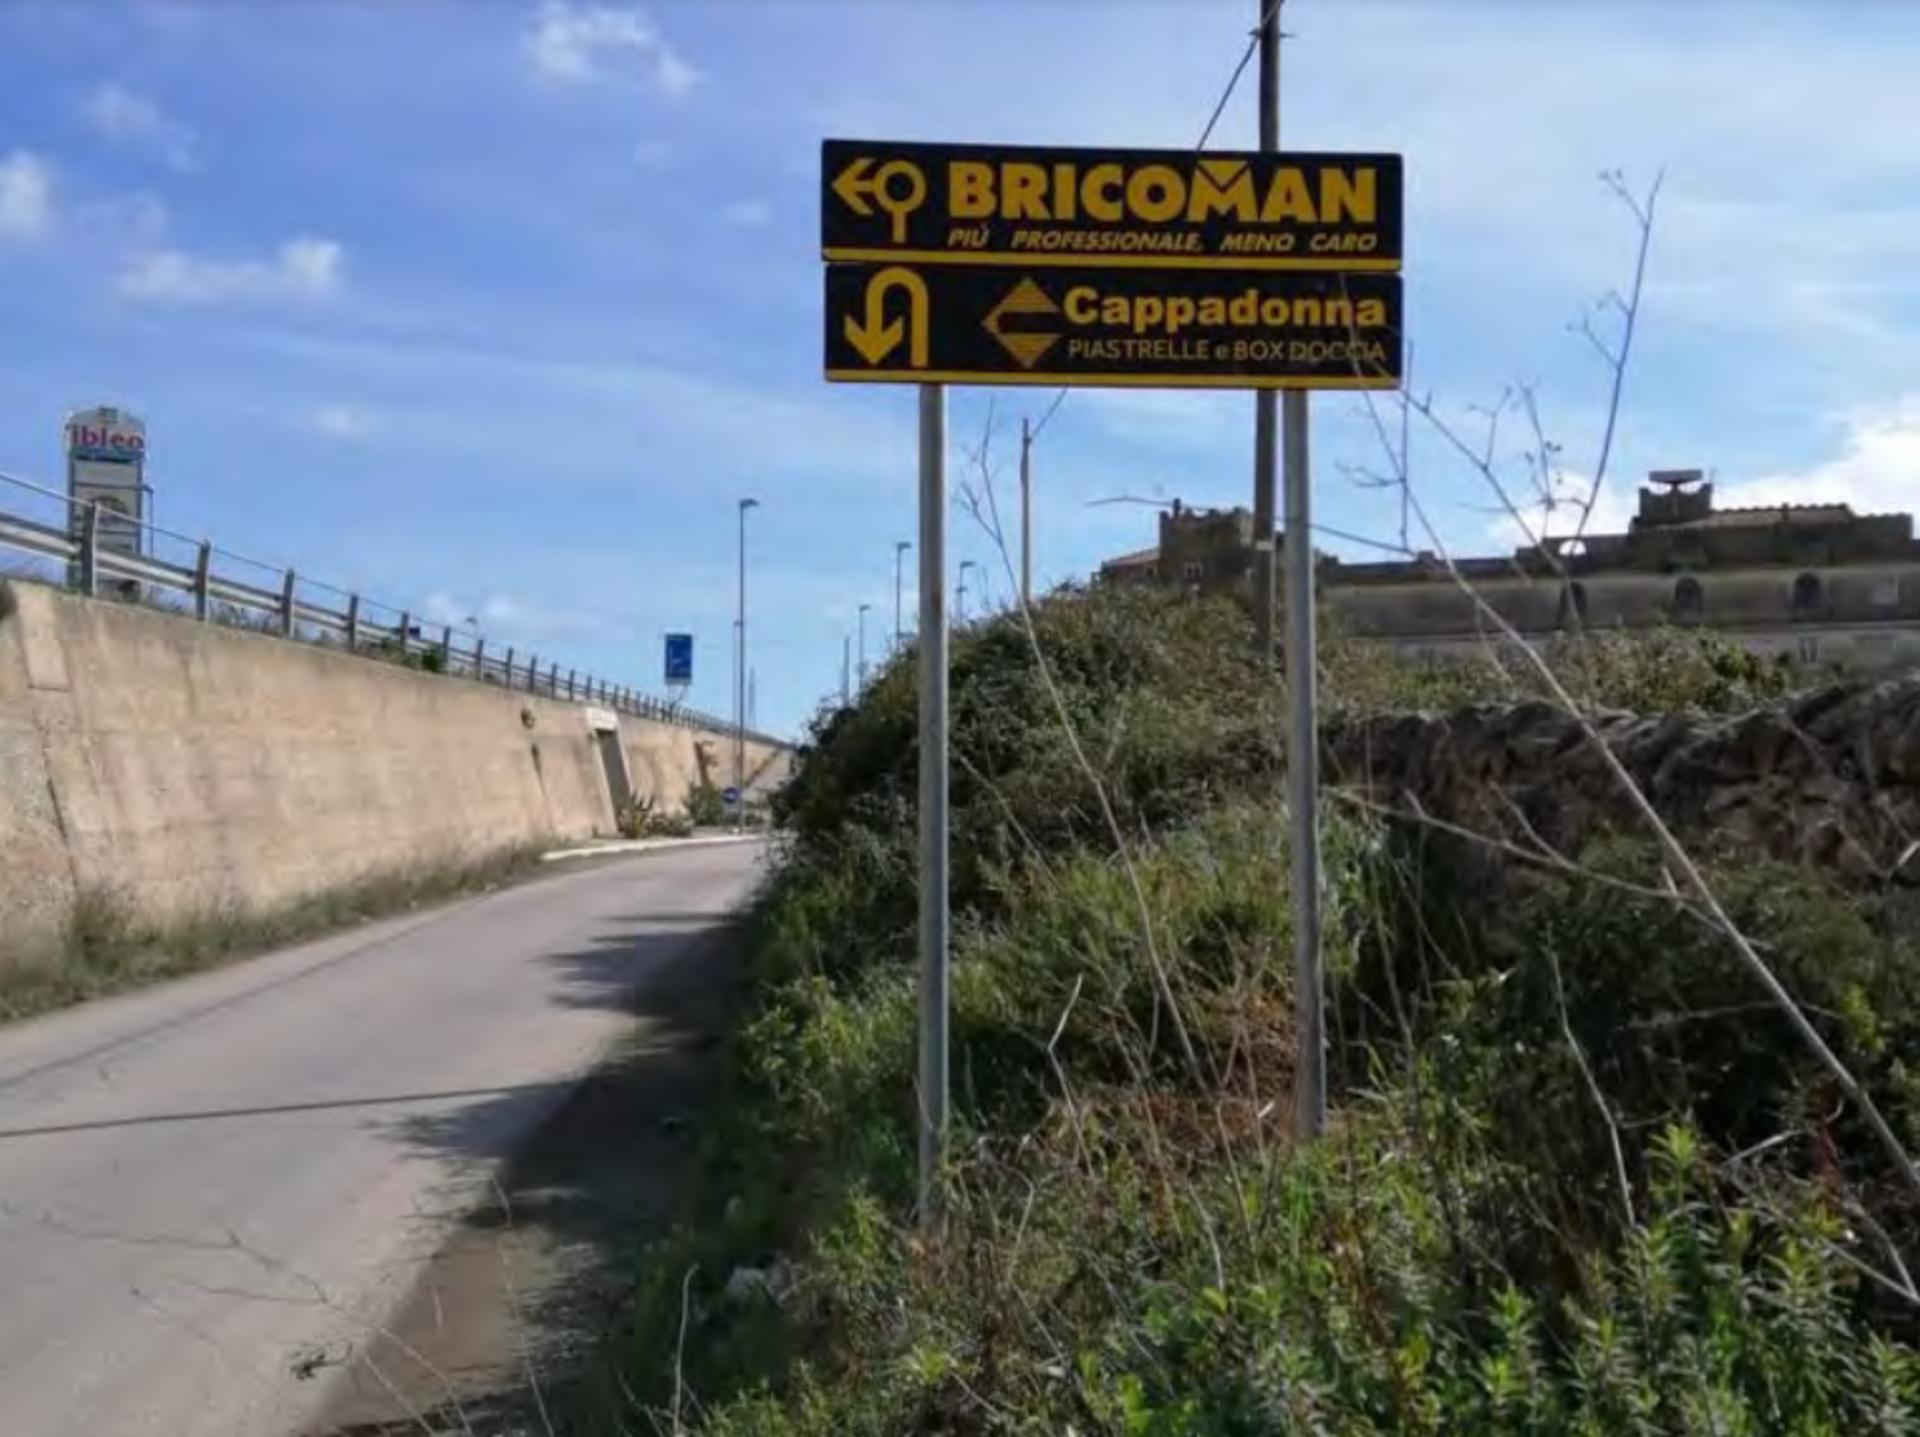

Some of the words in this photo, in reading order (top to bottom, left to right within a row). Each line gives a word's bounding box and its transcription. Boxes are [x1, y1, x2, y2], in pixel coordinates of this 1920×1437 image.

[949, 160, 1377, 222] BRICOMAN
[948, 223, 990, 248] PIÙ
[1220, 232, 1295, 252] MENO
[1308, 232, 1378, 251] CARO
[1064, 286, 1386, 333] Cappadonna
[1068, 338, 1210, 361] PIASTRELLE
[1214, 344, 1230, 362] e
[1233, 339, 1285, 362] BOX
